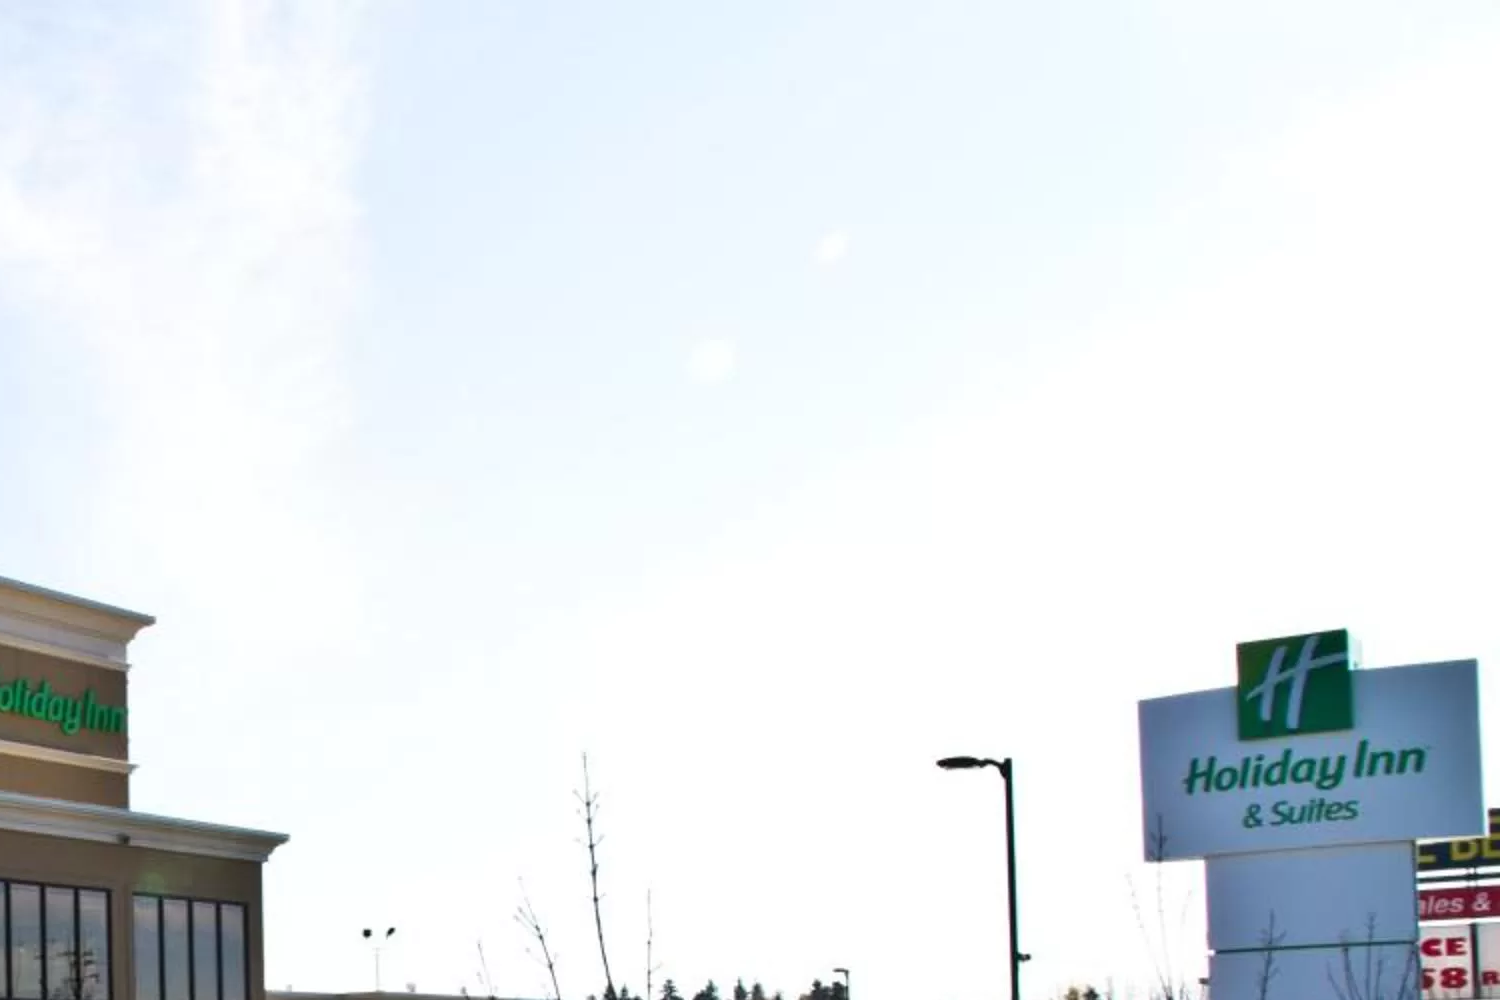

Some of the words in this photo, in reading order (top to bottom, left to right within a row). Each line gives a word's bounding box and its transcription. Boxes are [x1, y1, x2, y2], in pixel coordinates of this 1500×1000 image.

[84, 687, 125, 733] Inn
[1183, 749, 1346, 795] Holiday
[1353, 739, 1426, 778] Inn
[1242, 803, 1263, 829] &
[1270, 798, 1359, 826] Suites
[1472, 892, 1491, 912] &
[1420, 936, 1467, 957] CE
